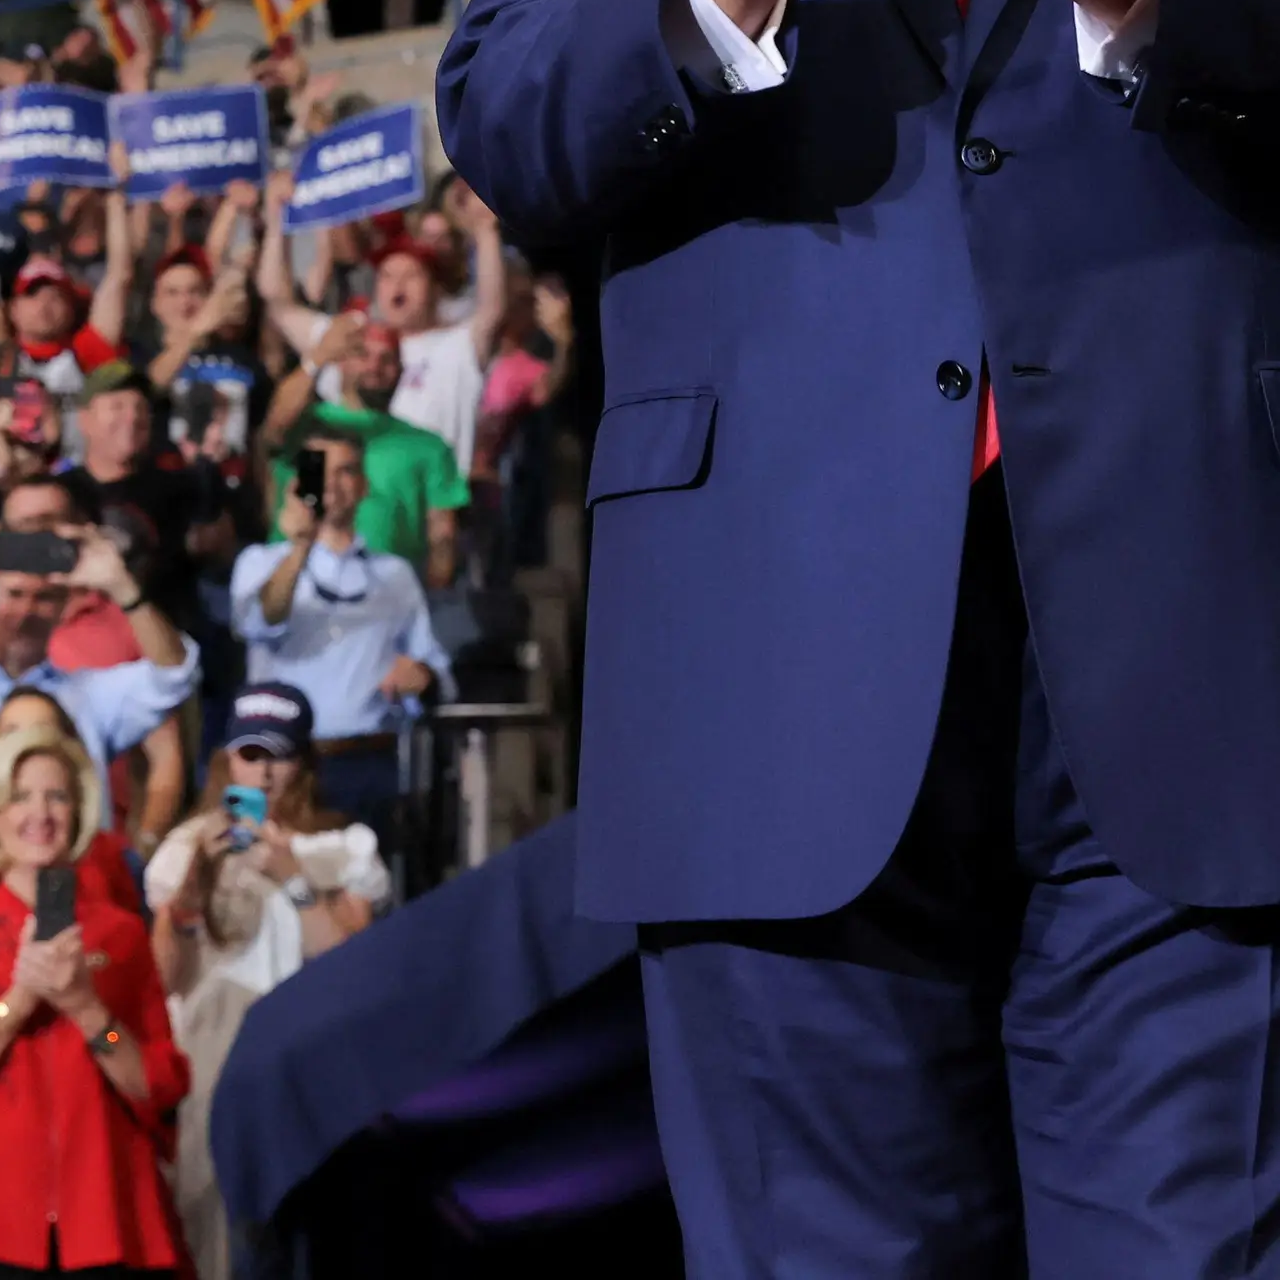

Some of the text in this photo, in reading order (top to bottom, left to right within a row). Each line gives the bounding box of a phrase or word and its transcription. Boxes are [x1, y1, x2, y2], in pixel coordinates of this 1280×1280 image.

[152, 110, 226, 143] SAVE
[129, 138, 258, 174] AMERICA!
[317, 131, 384, 172] SAVE
[291, 151, 413, 208] AMERICA!
